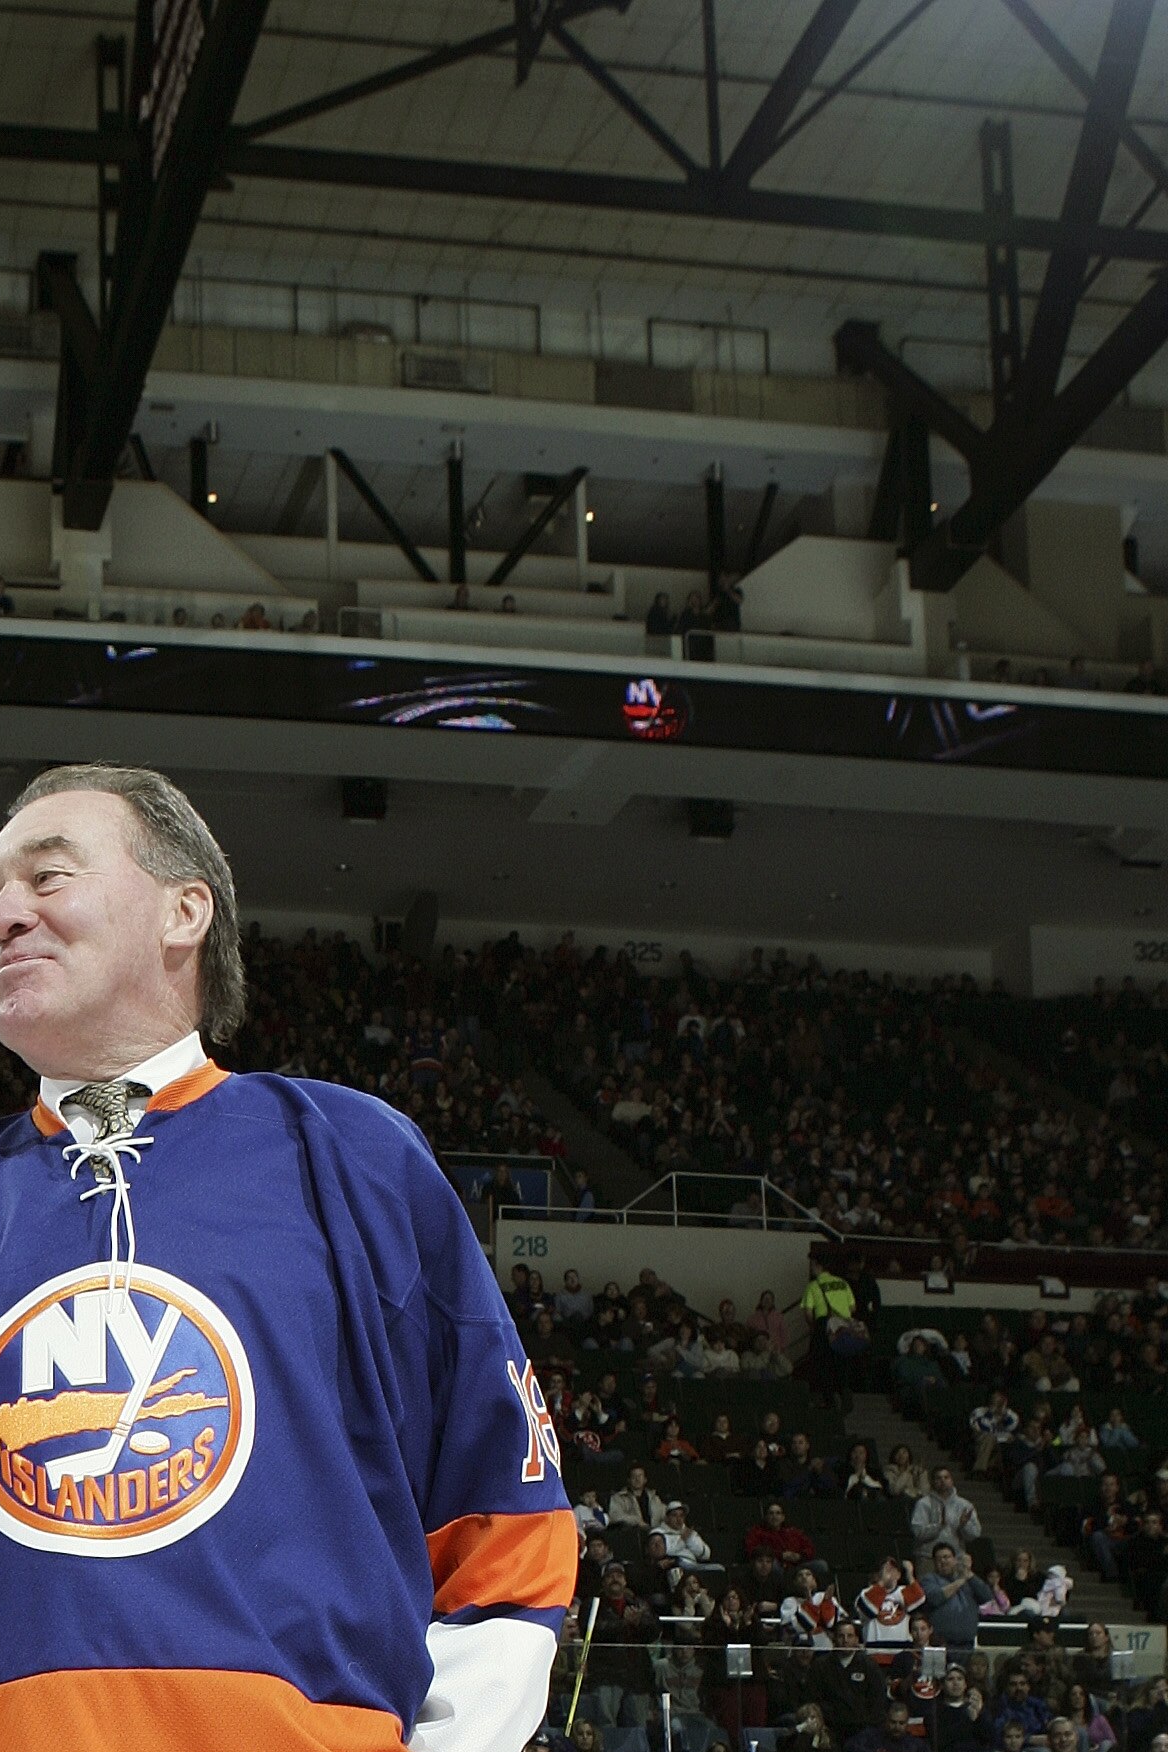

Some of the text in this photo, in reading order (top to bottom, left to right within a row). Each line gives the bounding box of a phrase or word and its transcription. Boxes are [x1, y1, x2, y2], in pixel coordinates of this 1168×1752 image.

[625, 941, 663, 962] 325
[513, 1235, 549, 1257] 218
[22, 1288, 182, 1394] NY
[1128, 1632, 1152, 1650] 117
